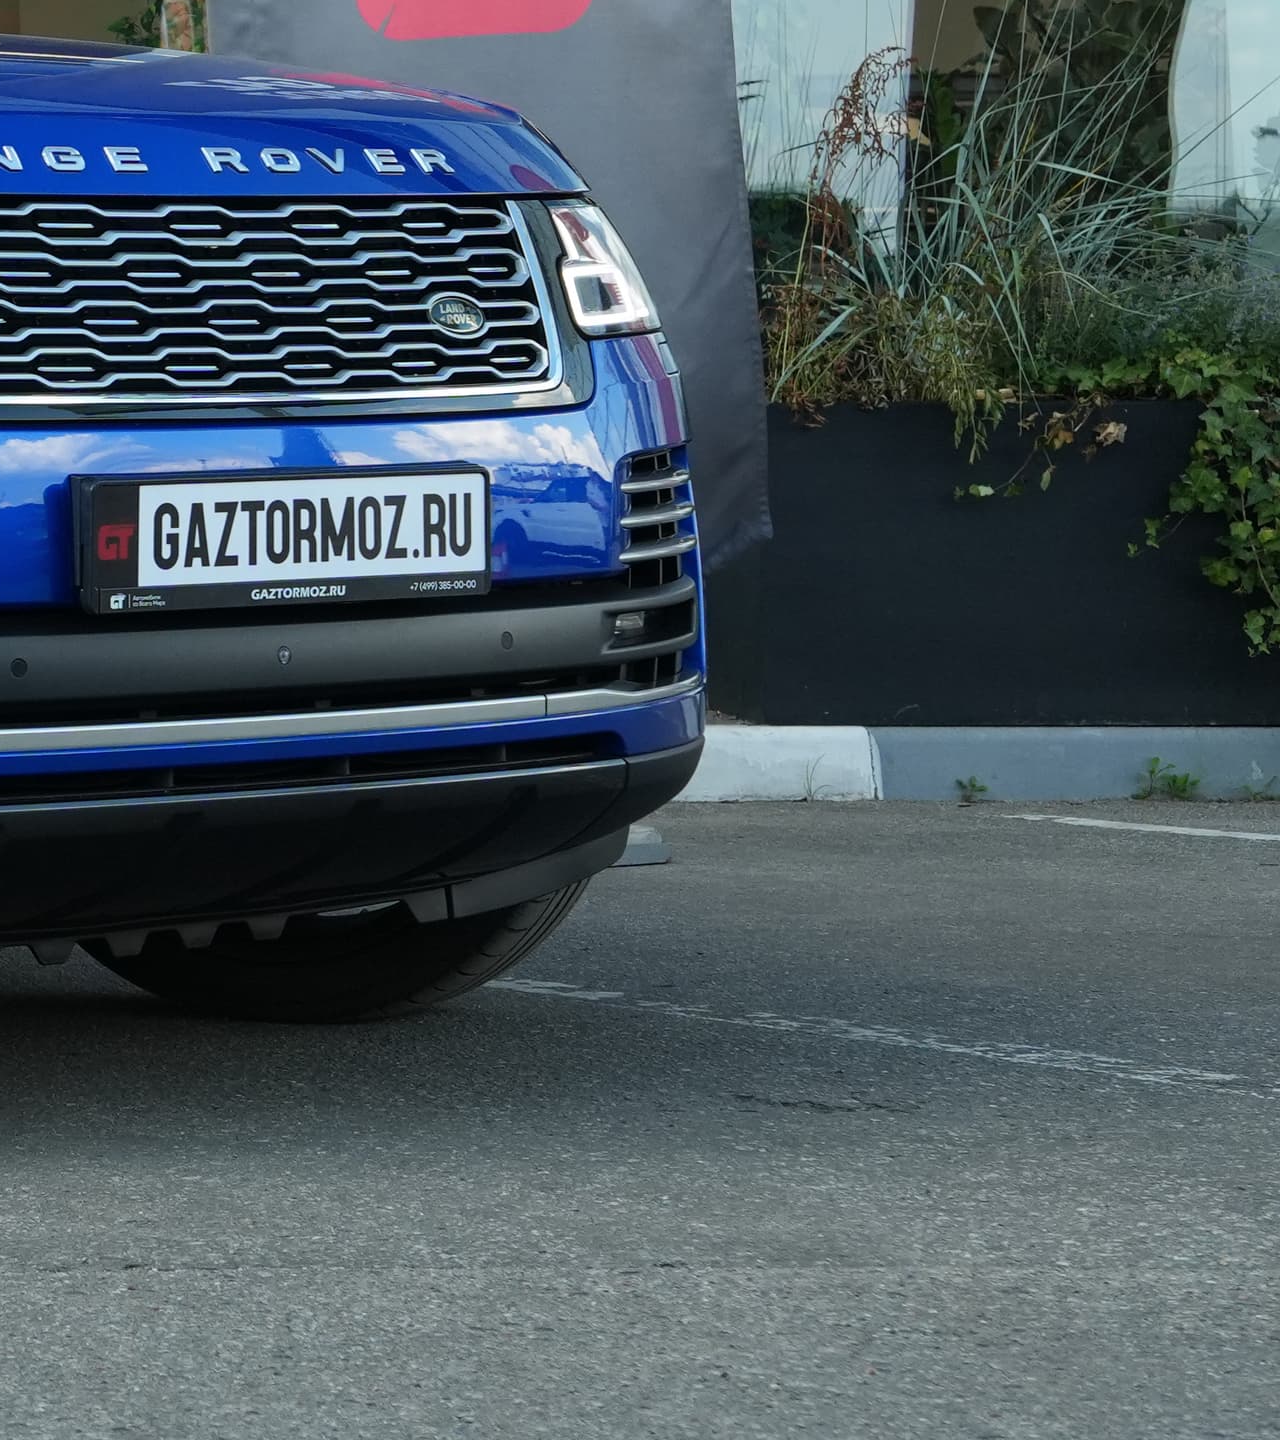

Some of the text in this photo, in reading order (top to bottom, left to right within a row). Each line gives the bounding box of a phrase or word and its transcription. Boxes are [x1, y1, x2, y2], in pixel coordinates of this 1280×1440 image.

[201, 146, 456, 175] ROVER
[439, 303, 465, 314] LAND
[446, 313, 478, 325] ROVER
[152, 492, 473, 570] GAZTORMOZ.RU
[97, 523, 136, 561] GT
[251, 584, 346, 600] GAZTORMOZ.RU
[419, 580, 438, 592] (499)
